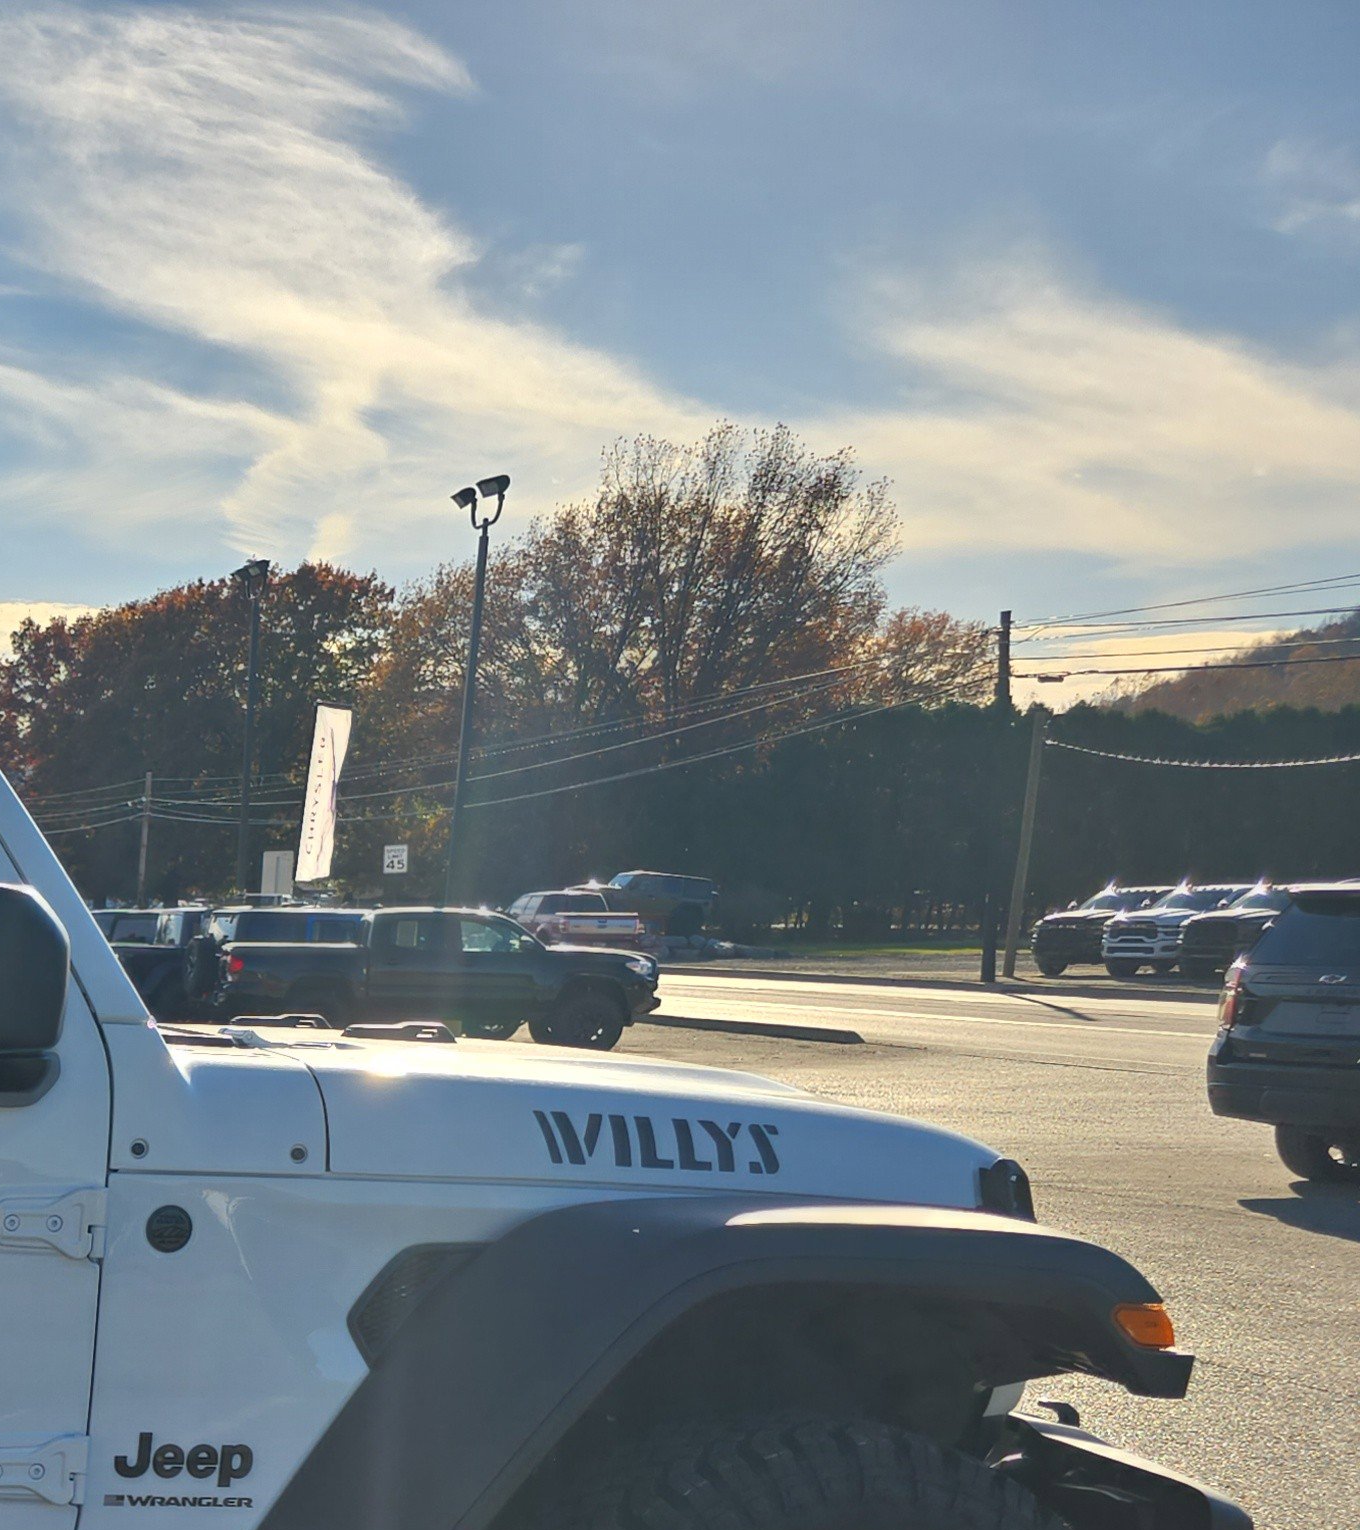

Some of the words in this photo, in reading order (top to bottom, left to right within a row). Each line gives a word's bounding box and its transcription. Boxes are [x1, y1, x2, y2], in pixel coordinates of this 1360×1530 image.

[386, 860, 405, 870] 45
[532, 1110, 780, 1175] WILLYS
[113, 1431, 254, 1488] Jeep
[126, 1494, 254, 1509] WRANGLER
